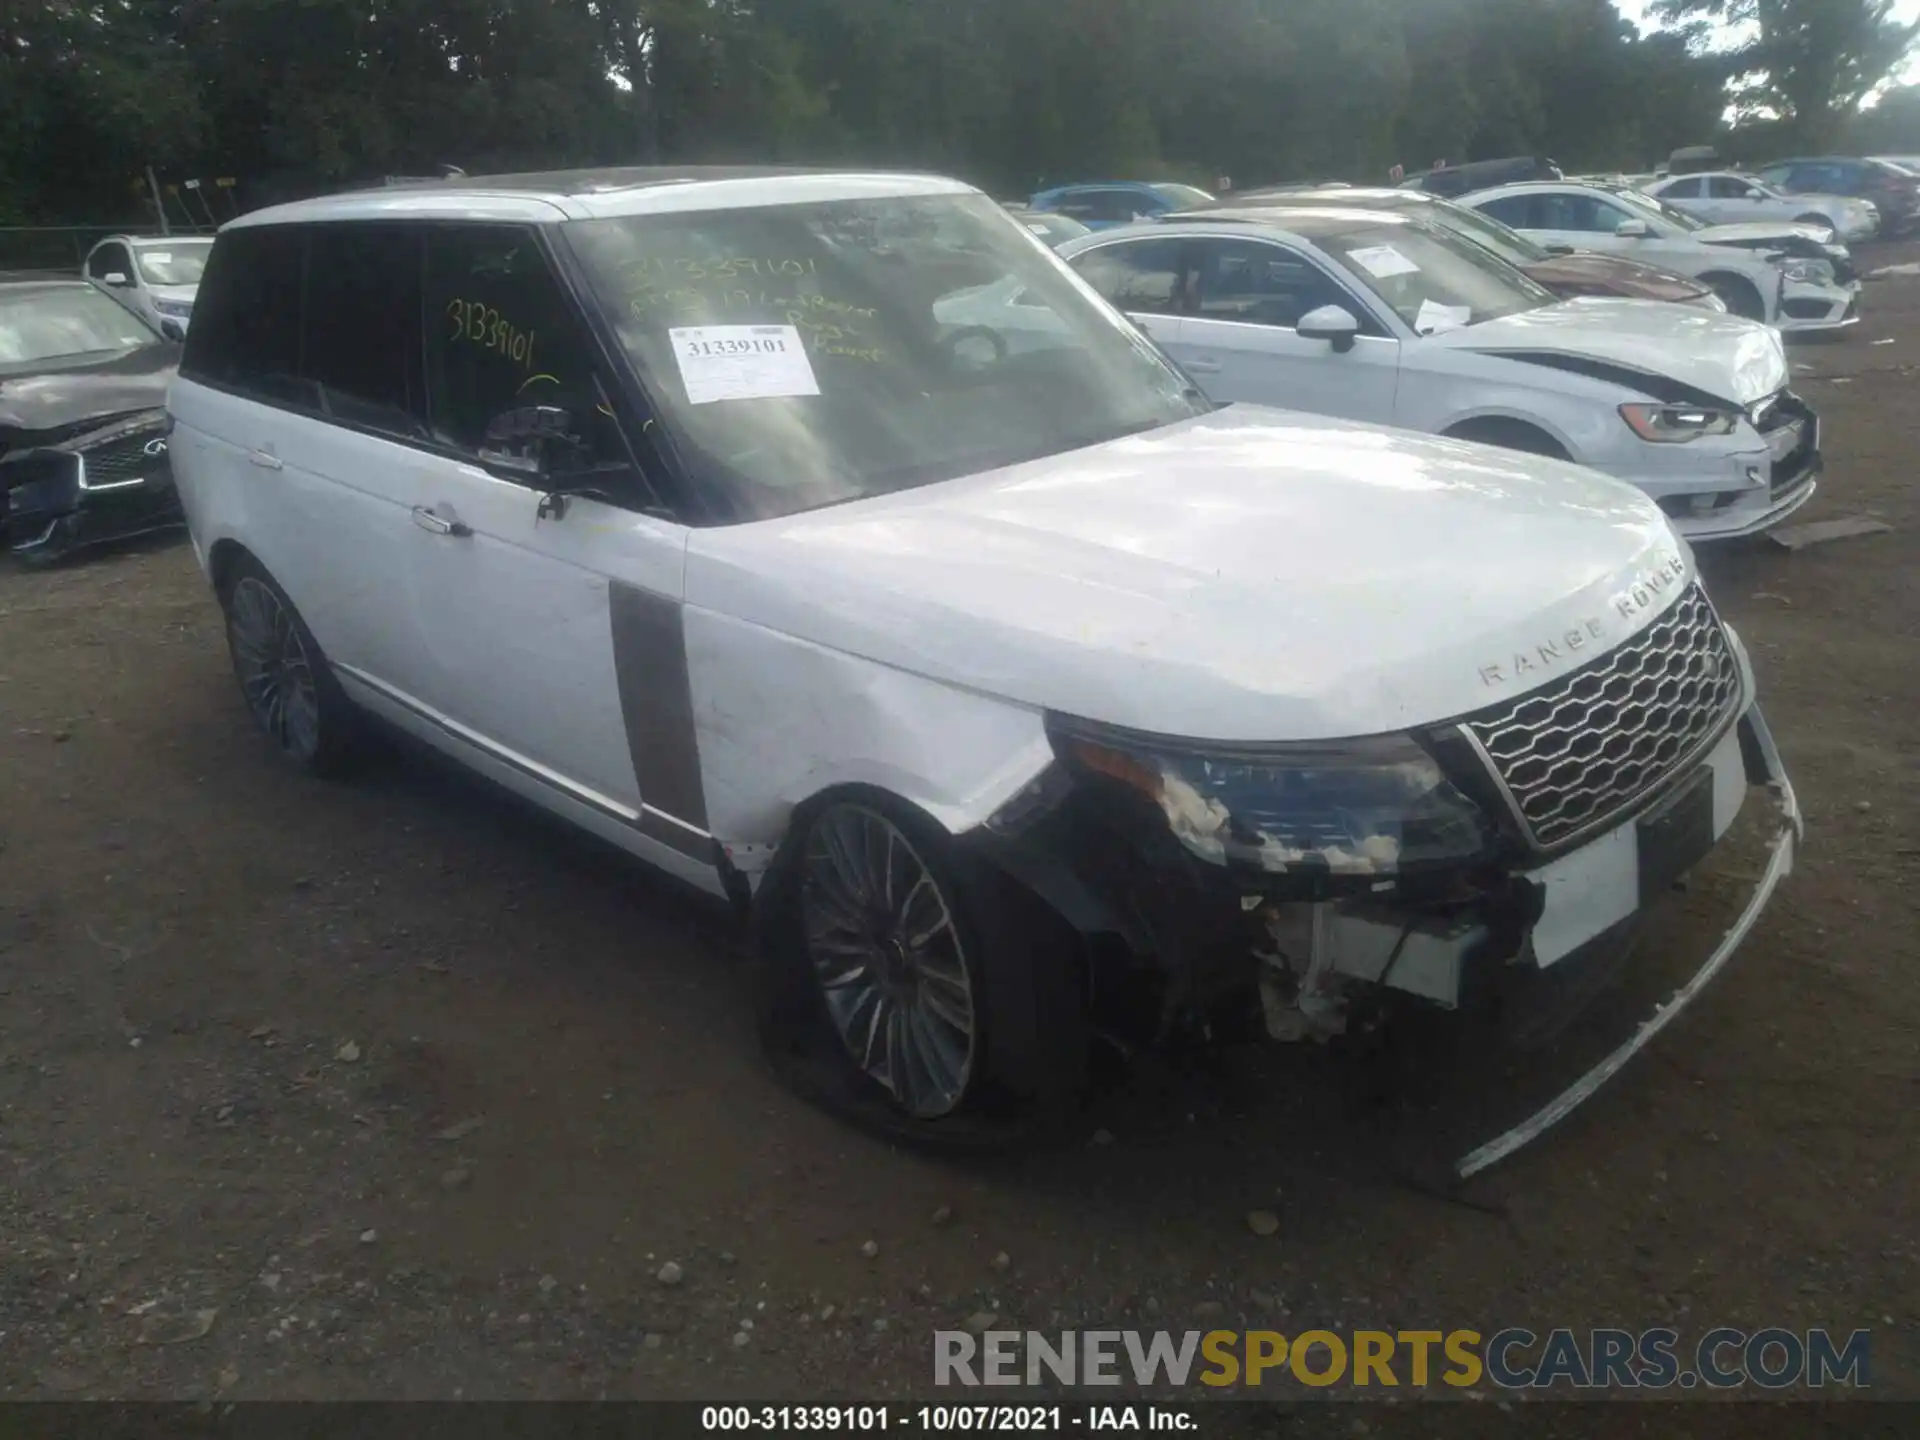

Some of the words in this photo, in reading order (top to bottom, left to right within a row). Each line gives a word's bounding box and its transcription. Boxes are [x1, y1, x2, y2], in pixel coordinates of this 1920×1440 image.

[447, 298, 535, 369] 31339101
[688, 338, 786, 357] 31339101
[1478, 616, 1607, 687] RANGE
[1614, 555, 1685, 619] ROVER
